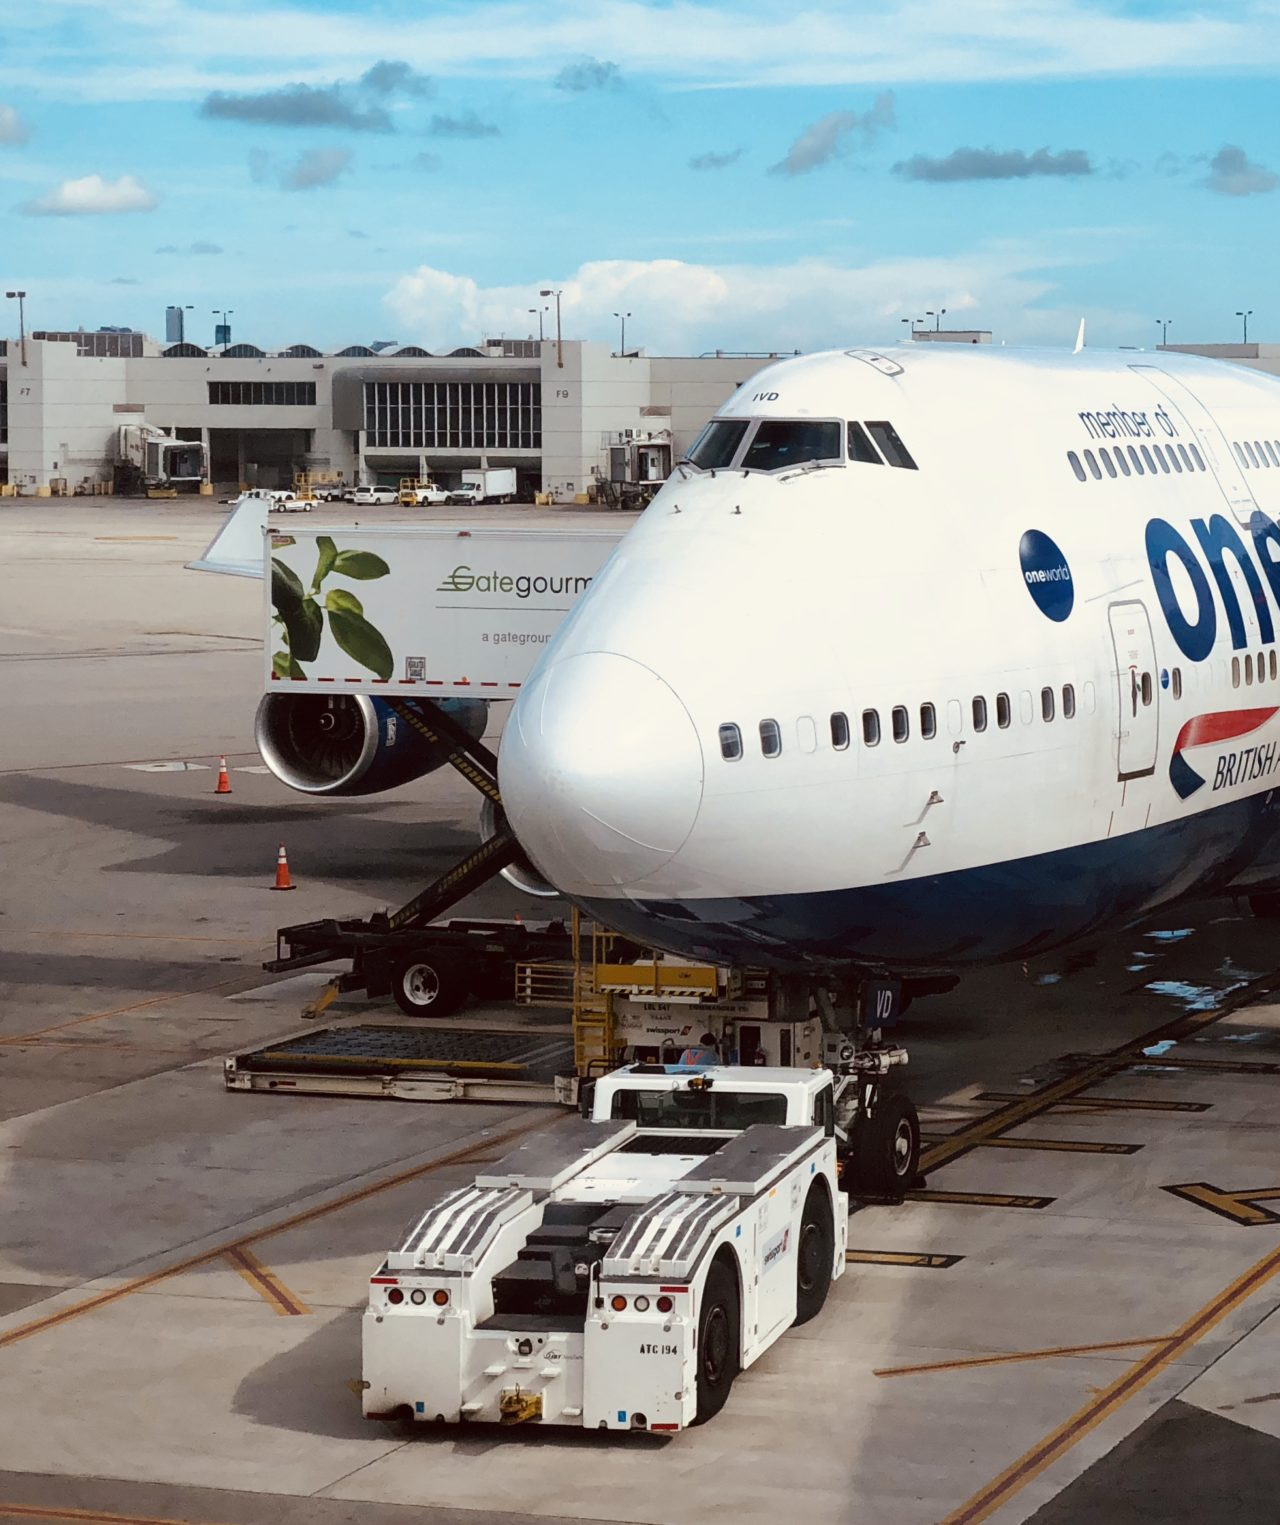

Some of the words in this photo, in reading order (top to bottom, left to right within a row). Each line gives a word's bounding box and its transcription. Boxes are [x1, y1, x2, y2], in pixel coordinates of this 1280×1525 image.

[556, 389, 569, 399] F9
[752, 392, 779, 402] IVD
[1078, 403, 1155, 439] member
[1155, 403, 1179, 437] of
[1025, 564, 1070, 583] oneworld
[482, 633, 489, 642] a
[1212, 741, 1278, 791] BRITISH
[876, 990, 892, 1018] VD
[646, 1026, 681, 1036] swissport
[639, 1344, 658, 1354] ATC
[661, 1345, 677, 1355] 194
